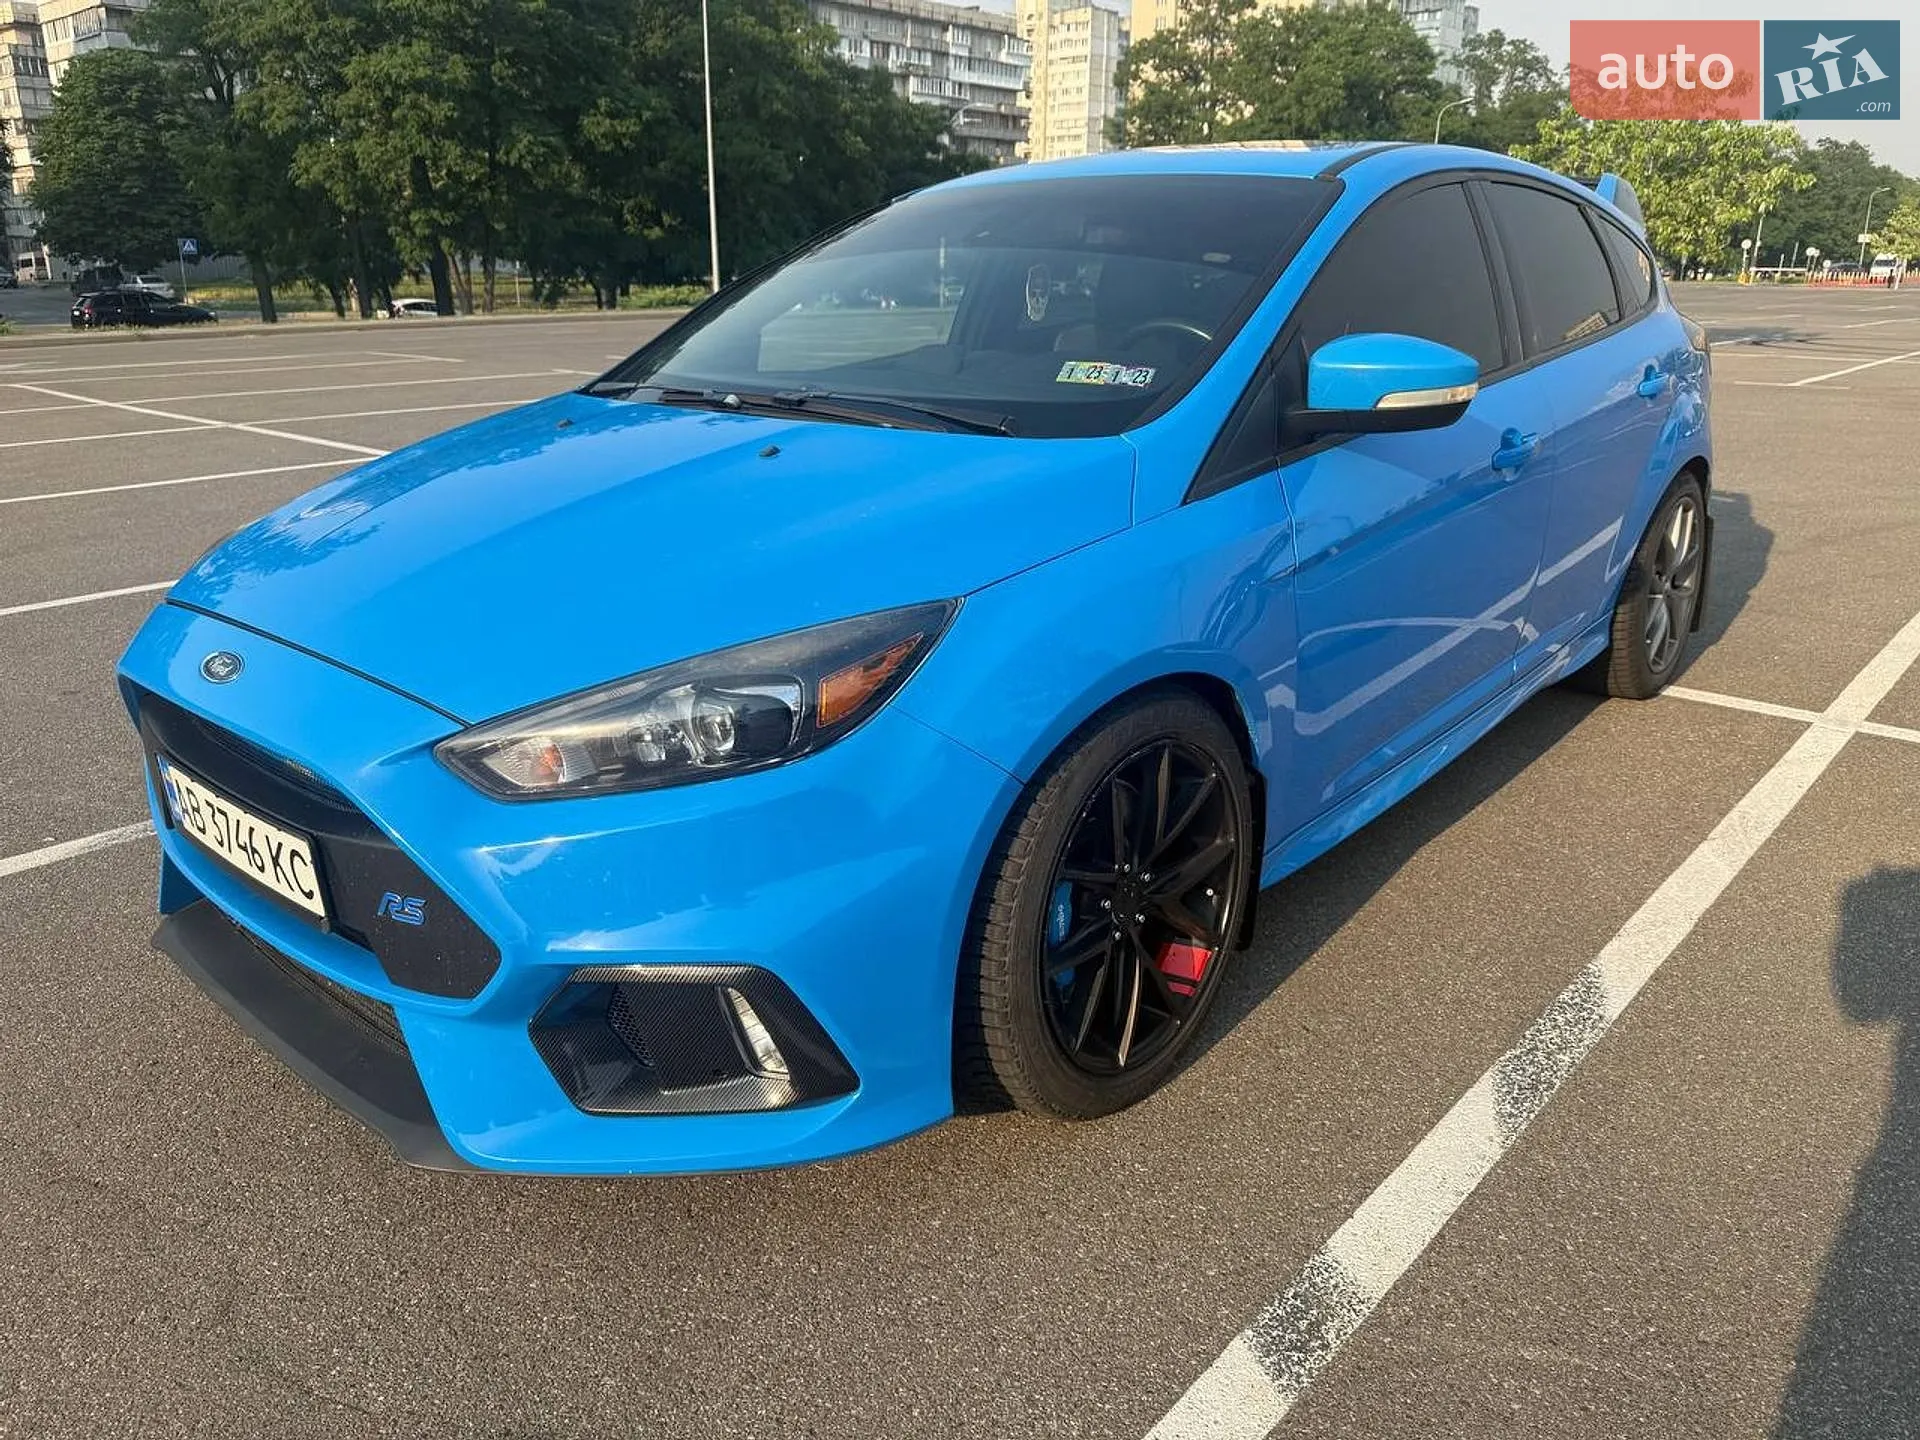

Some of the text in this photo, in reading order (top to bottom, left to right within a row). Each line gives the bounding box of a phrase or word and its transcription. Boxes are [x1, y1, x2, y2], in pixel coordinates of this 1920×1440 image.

[1132, 369, 1150, 384] 23
[175, 778, 315, 900] AB 3746 KC
[376, 892, 428, 926] RS
